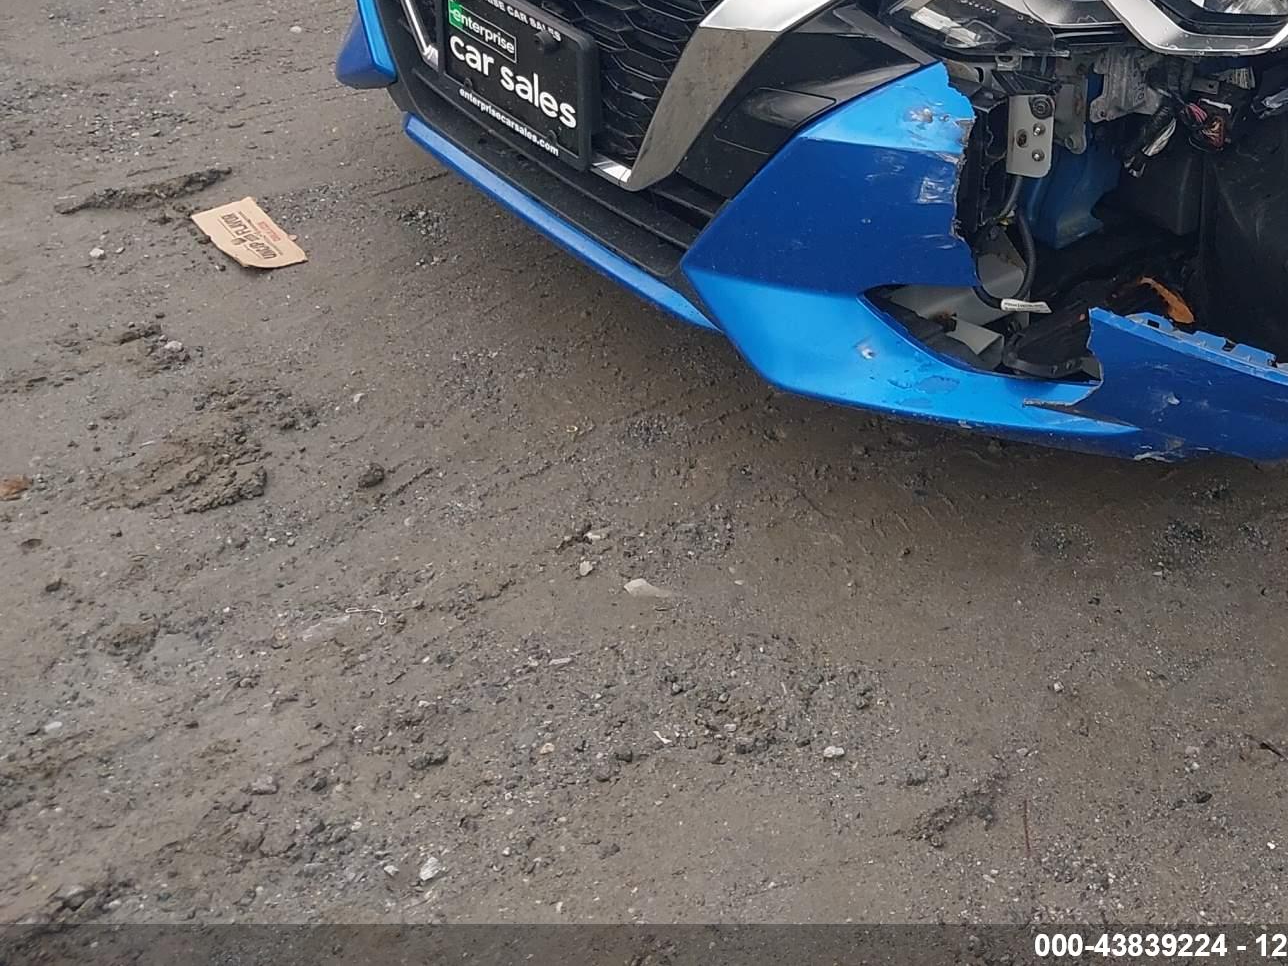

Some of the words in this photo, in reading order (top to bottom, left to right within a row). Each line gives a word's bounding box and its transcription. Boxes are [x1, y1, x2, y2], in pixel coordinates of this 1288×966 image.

[450, 6, 515, 54] enterprise
[506, 5, 529, 25] CAR
[450, 35, 495, 76] car
[500, 66, 577, 129] sales
[459, 87, 559, 156] enterprisecarsales.com
